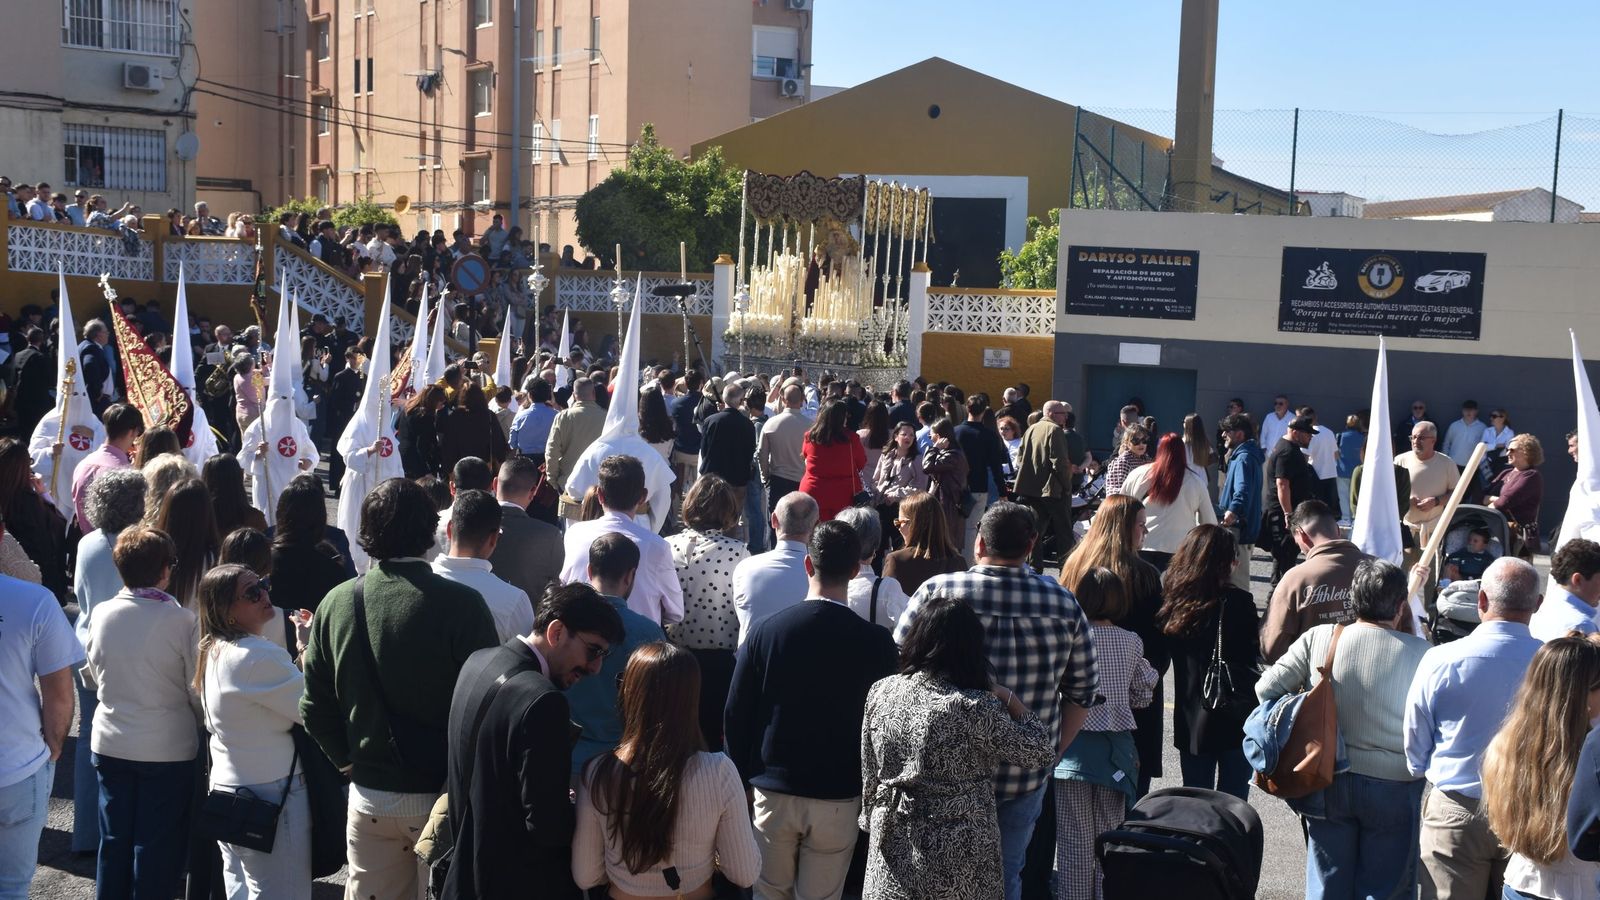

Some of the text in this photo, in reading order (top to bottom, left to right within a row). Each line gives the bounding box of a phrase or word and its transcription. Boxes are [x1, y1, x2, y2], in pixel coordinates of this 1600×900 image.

[1078, 252, 1192, 266] DARYSO TALLER
[1324, 301, 1356, 309] ACCESORIOS
[1364, 302, 1398, 311] AUTOMÓVILES
[1402, 304, 1440, 313] MOTOCICLETAS
[1345, 310, 1384, 320] vehículo
[1421, 313, 1431, 321] lo
